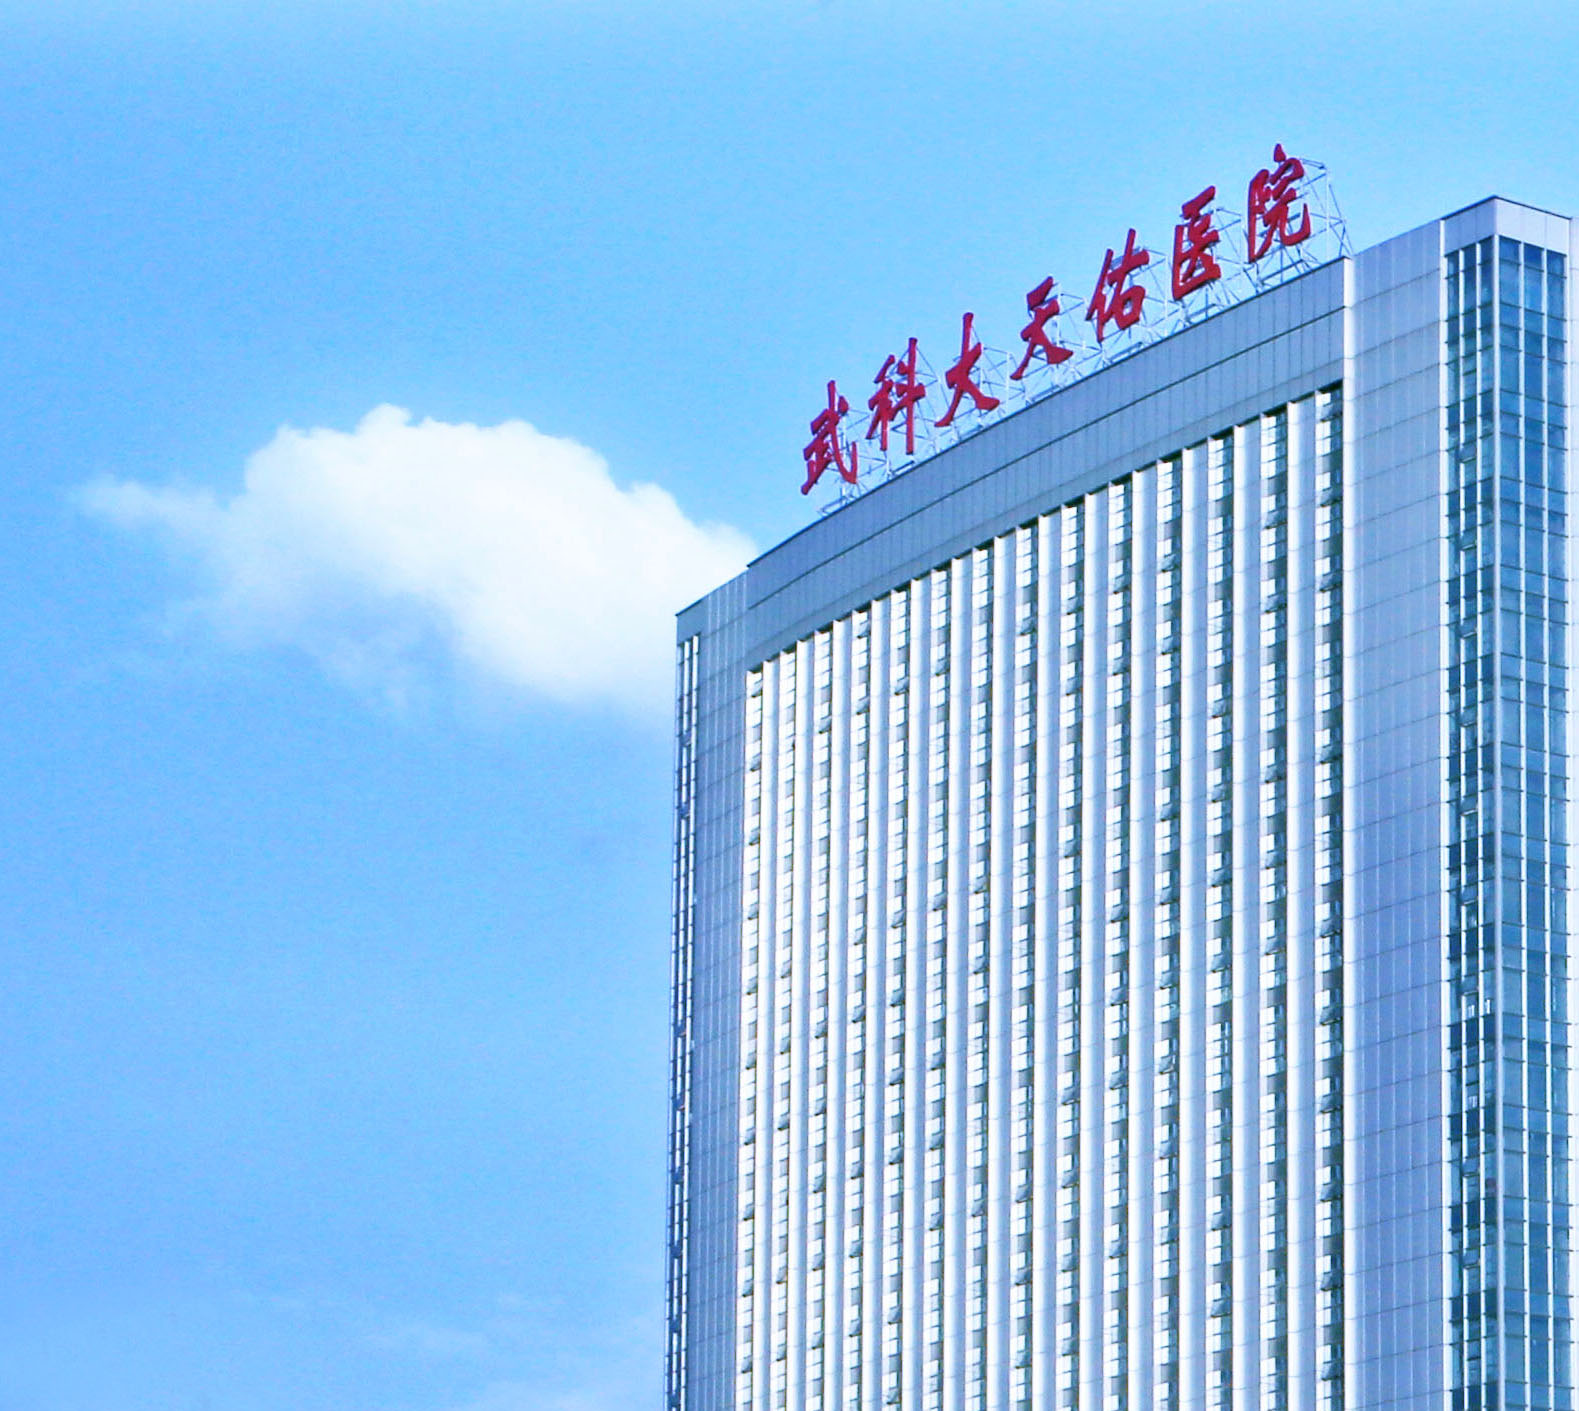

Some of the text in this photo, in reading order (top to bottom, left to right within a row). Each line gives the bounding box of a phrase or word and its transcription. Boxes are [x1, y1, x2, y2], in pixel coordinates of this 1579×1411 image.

[801, 143, 1312, 495] 武科大天佑医院
